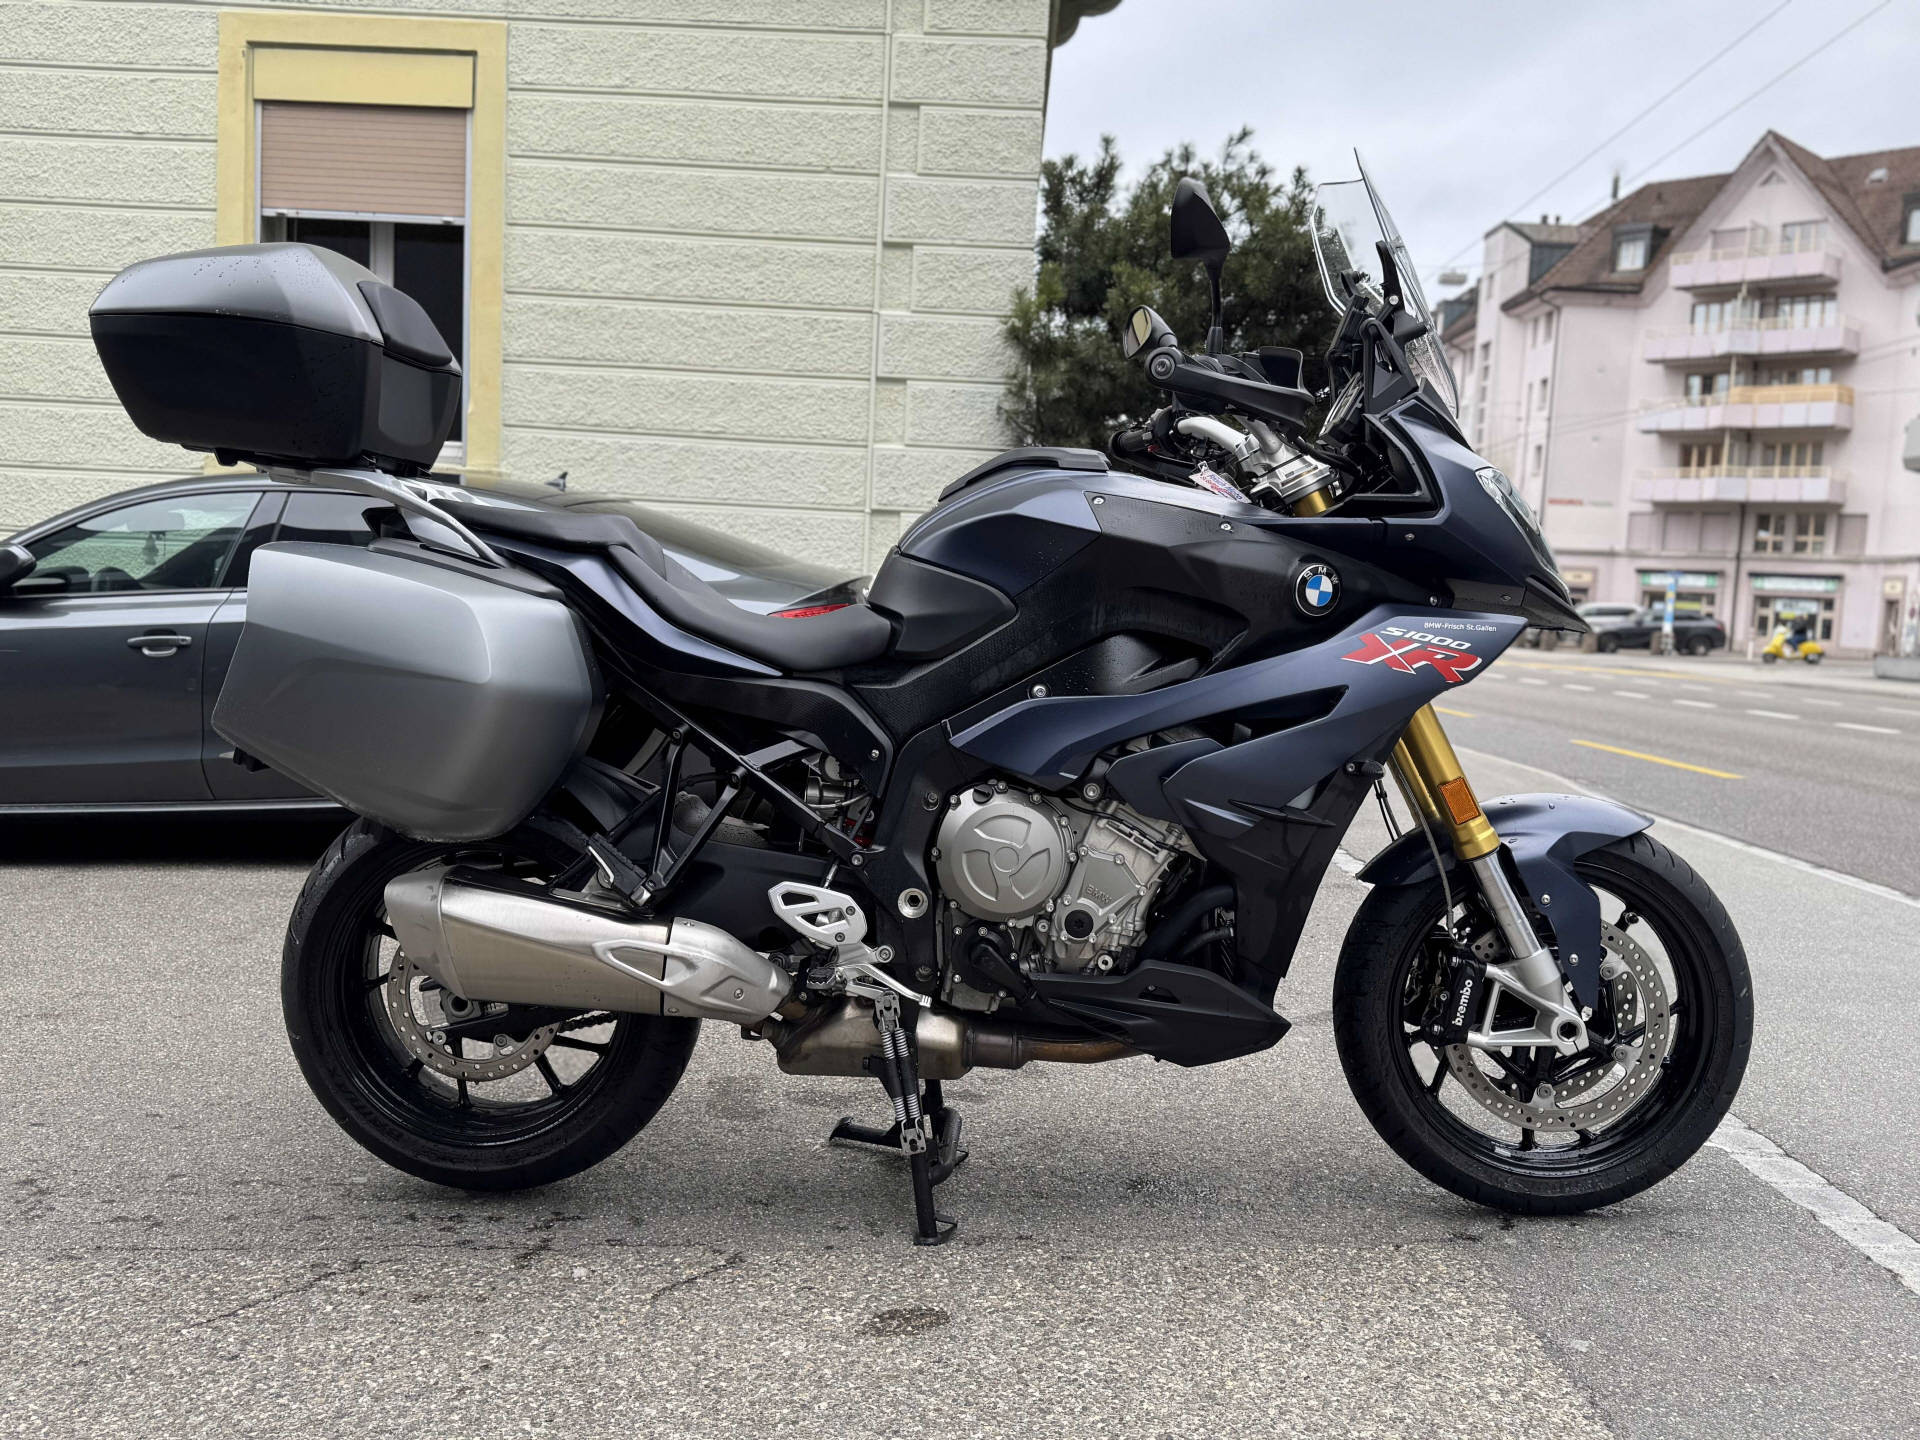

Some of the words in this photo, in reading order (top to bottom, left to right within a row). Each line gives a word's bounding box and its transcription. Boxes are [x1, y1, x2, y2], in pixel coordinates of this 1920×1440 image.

[1303, 566, 1339, 584] BMW
[1340, 632, 1482, 683] XR
[1451, 979, 1473, 1026] brembo
